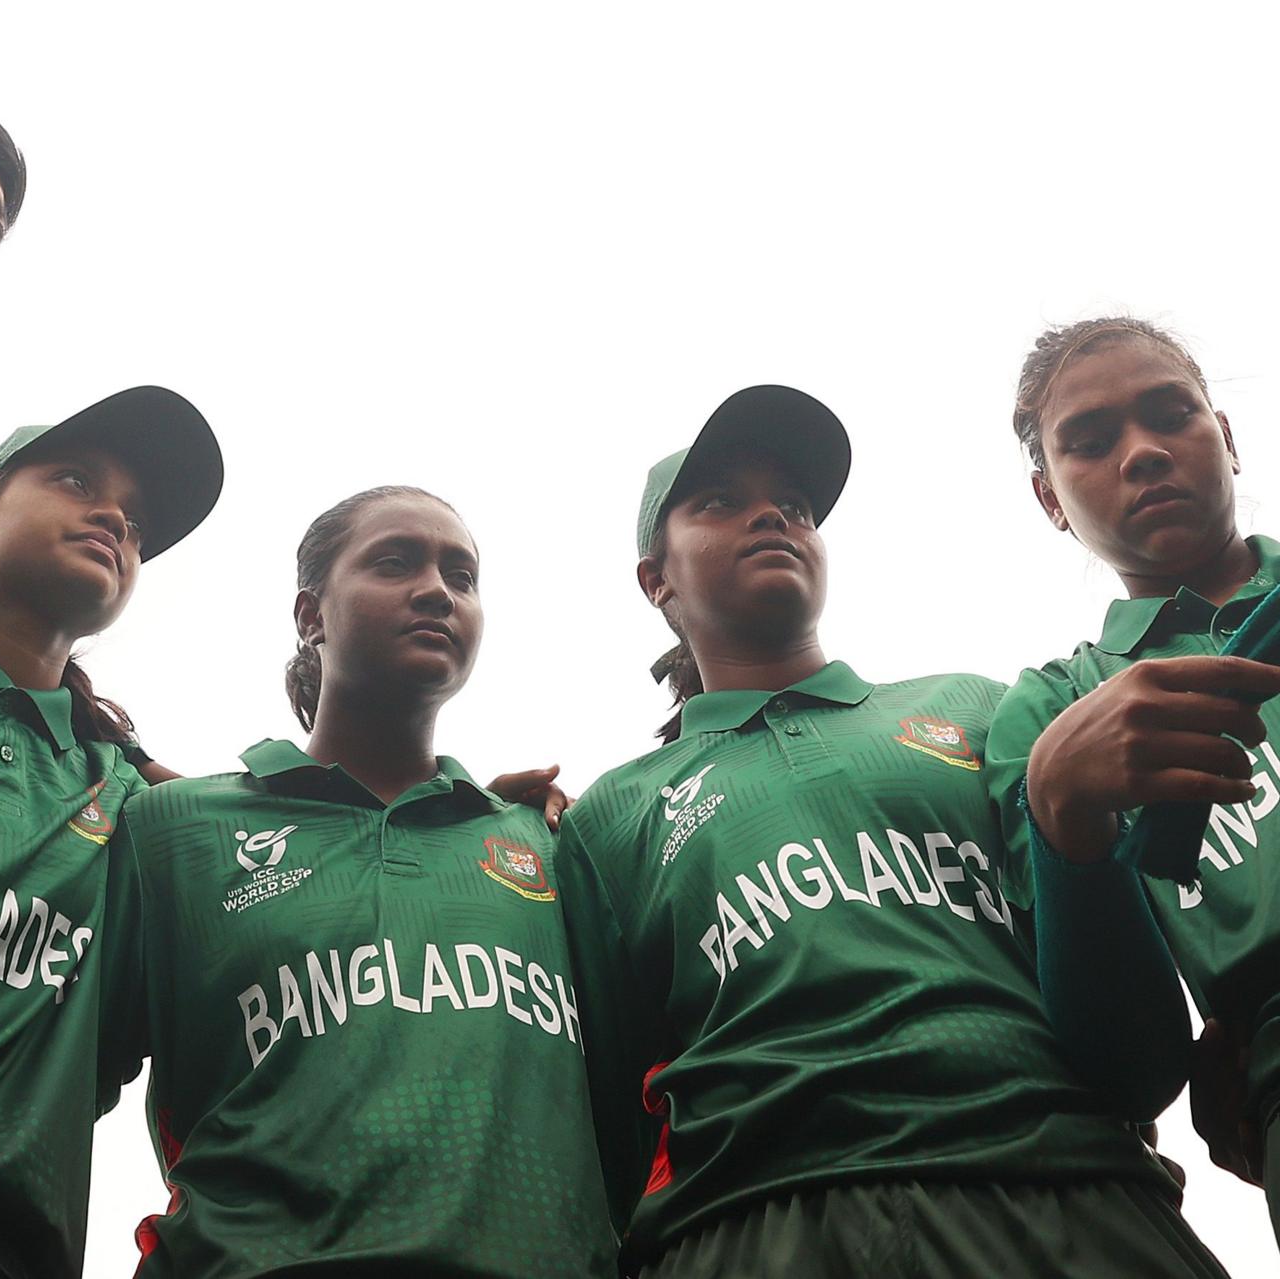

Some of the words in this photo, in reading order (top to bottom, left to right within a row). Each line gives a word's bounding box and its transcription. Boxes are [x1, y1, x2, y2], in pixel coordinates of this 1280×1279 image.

[675, 804, 692, 824] ICC
[697, 794, 725, 817] CUP
[670, 825, 698, 863] MALAYSIA
[227, 888, 243, 898] U19
[244, 872, 288, 891] WOMEN'S
[288, 868, 305, 878] T20
[252, 867, 276, 880] ICC
[222, 881, 279, 913] WORLD
[281, 868, 313, 887] CUP
[237, 890, 279, 913] MALAYSIA
[237, 938, 585, 1070] BANGLADESH
